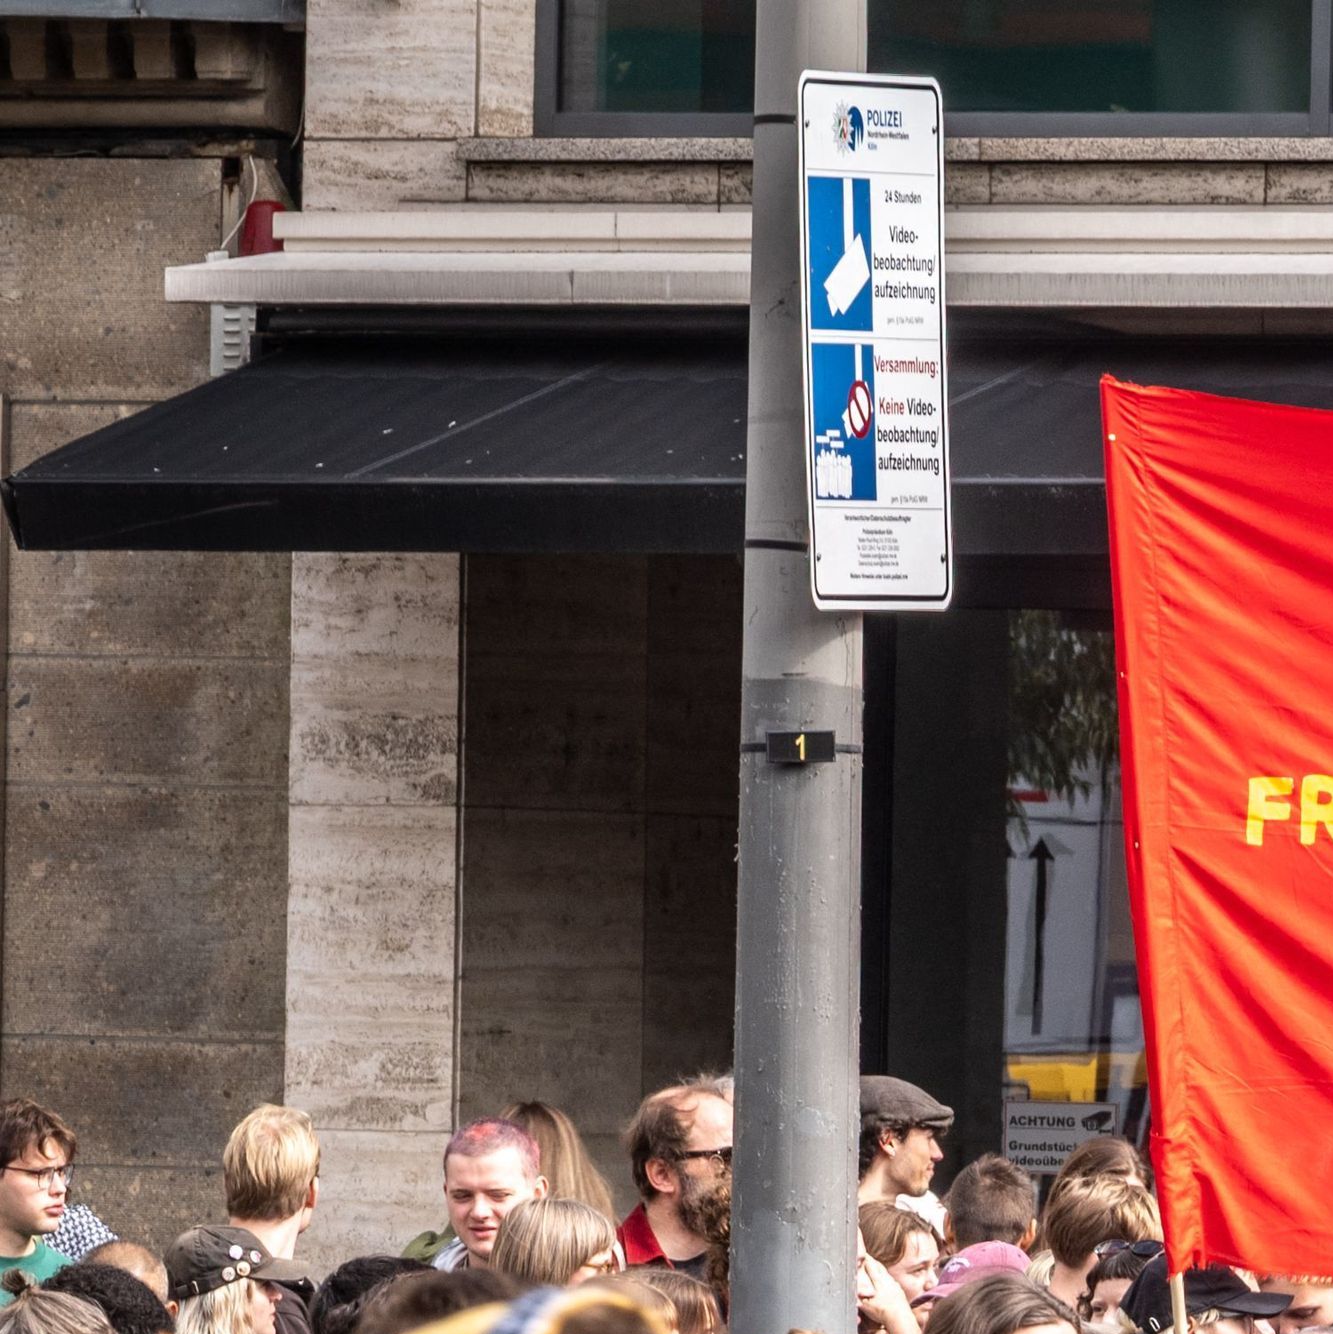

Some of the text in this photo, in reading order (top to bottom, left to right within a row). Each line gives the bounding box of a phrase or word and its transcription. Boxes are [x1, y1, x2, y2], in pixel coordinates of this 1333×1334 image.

[867, 110, 902, 127] POLIZEI
[884, 190, 922, 204] 24 Stunden
[889, 225, 919, 244] Video-
[873, 252, 936, 276] beobachtung/
[874, 280, 936, 304] aufzeichnung
[874, 356, 939, 378] Versammlung:
[879, 397, 937, 416] Keine Video-
[877, 425, 939, 448] beobachtung/
[878, 453, 940, 476] aufzeichnung
[795, 734, 806, 760] 1
[1009, 1115, 1076, 1128] ACHTUNG
